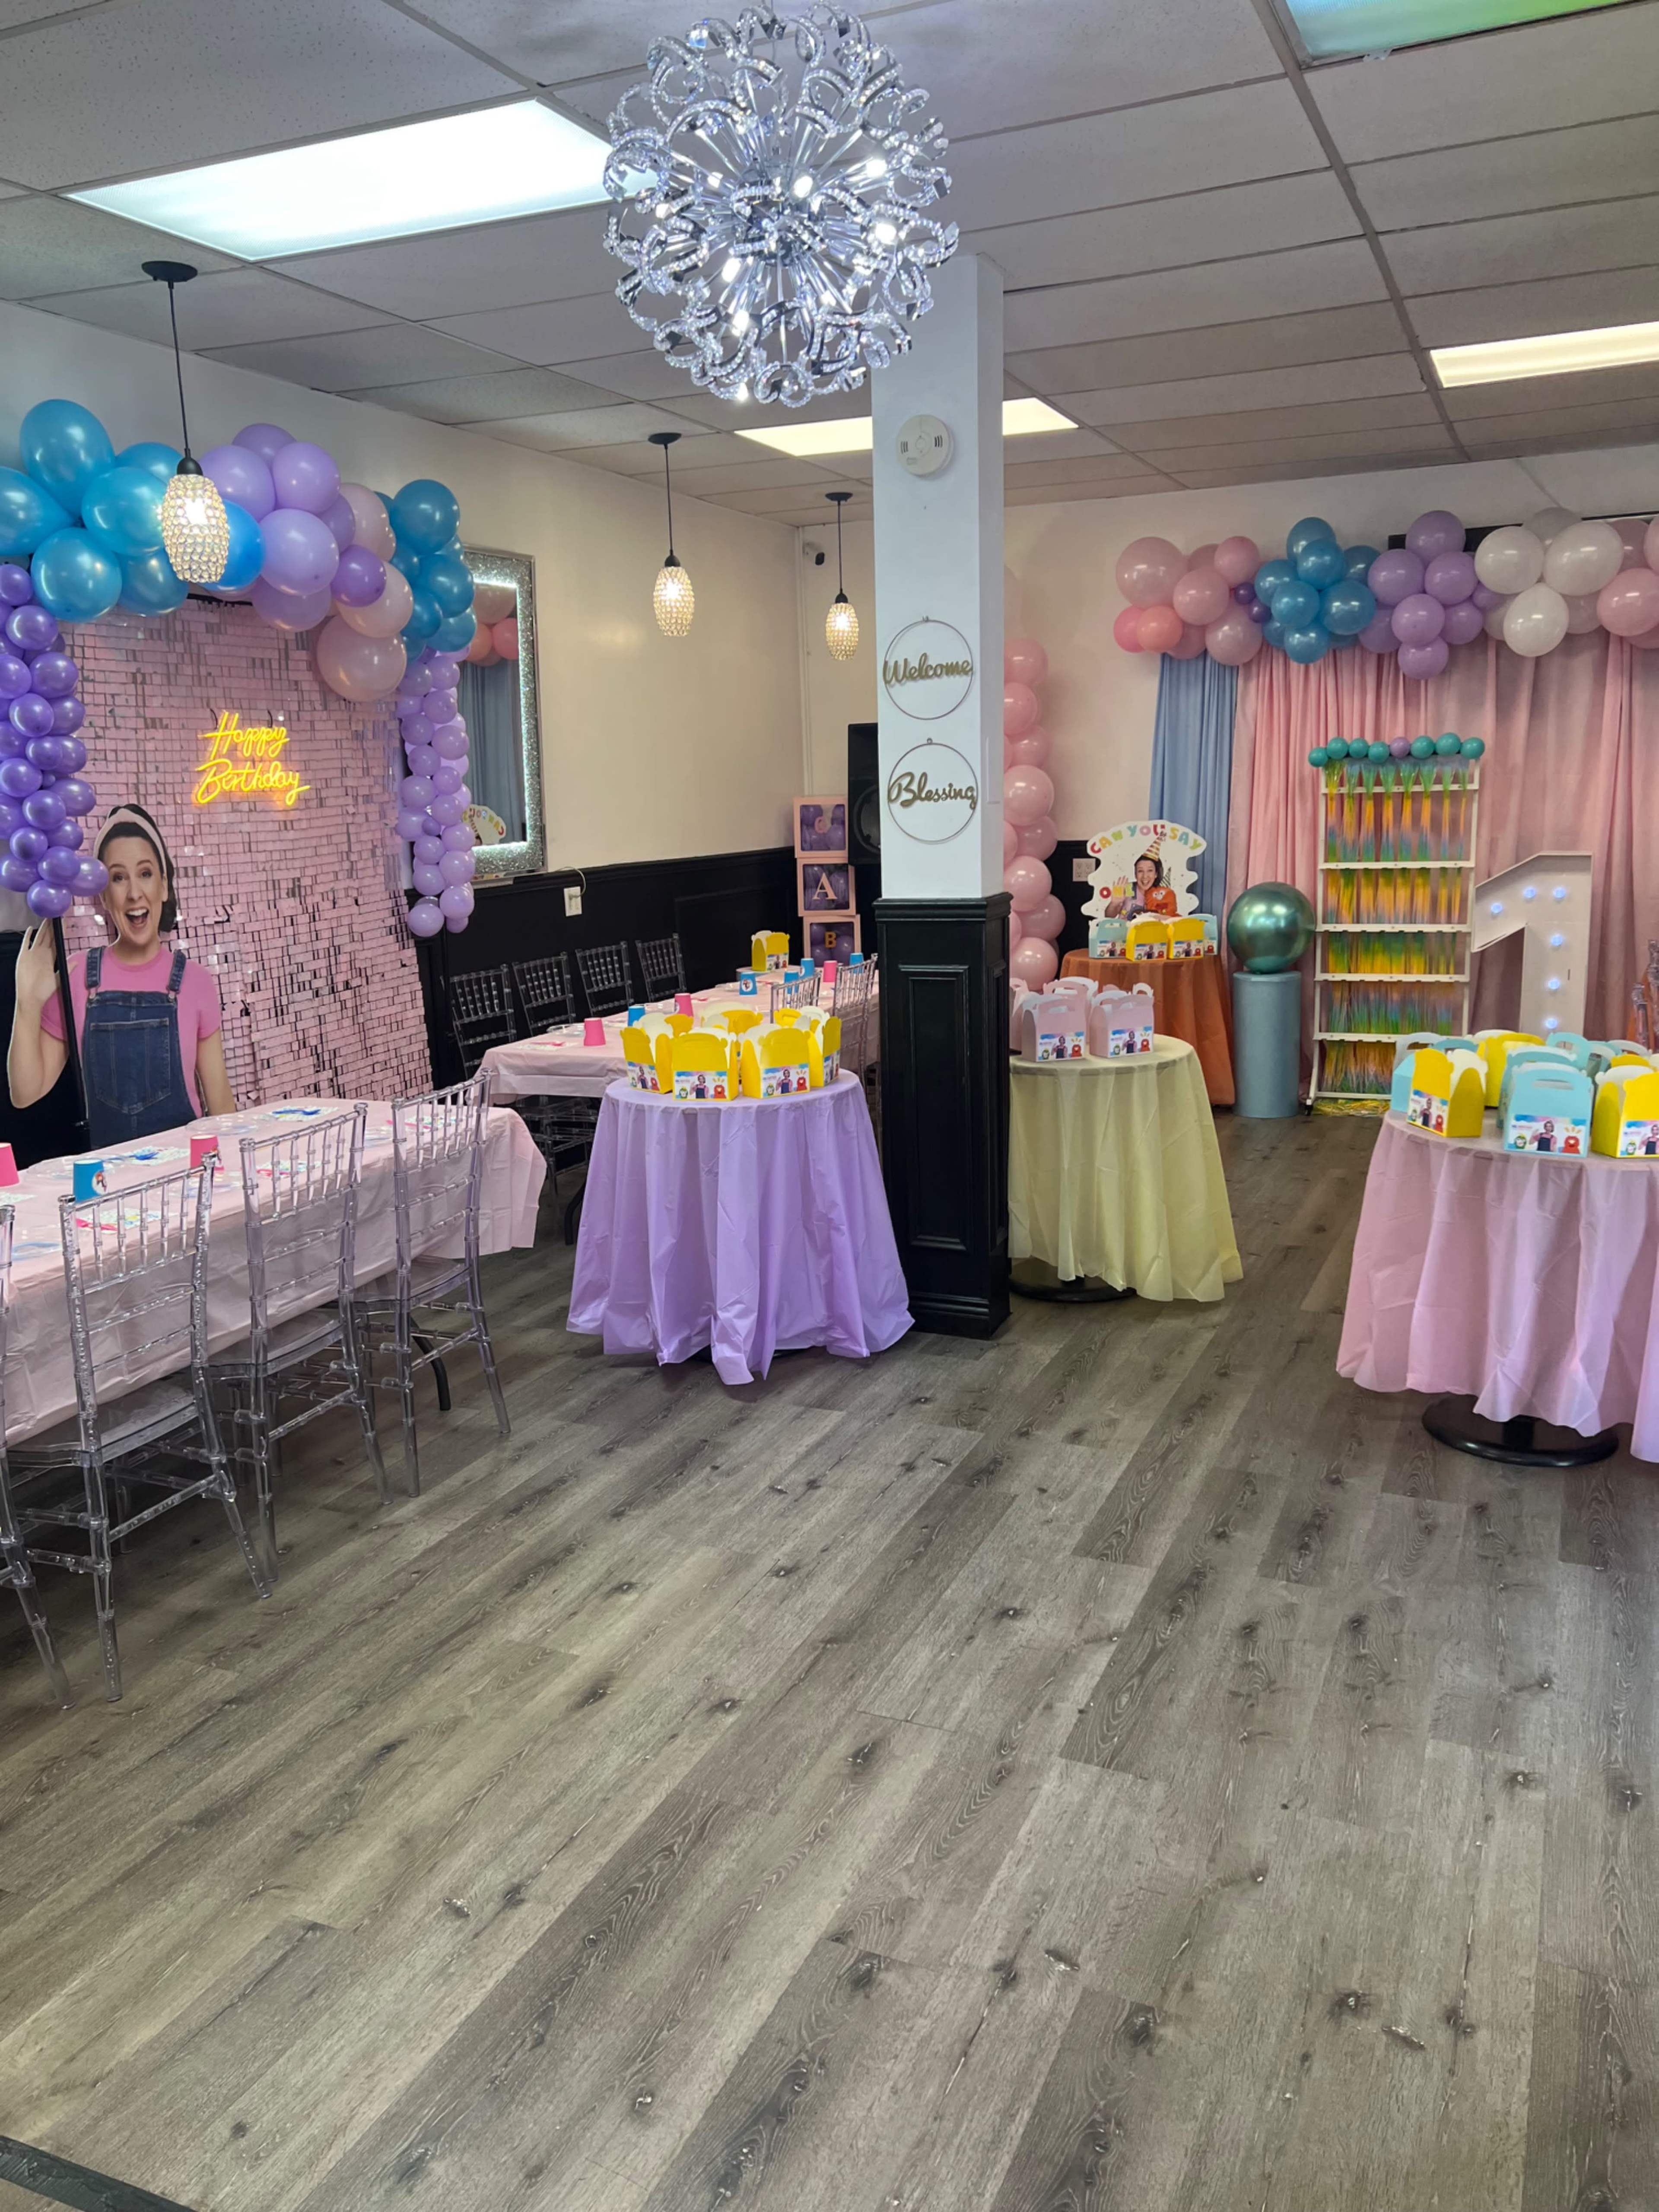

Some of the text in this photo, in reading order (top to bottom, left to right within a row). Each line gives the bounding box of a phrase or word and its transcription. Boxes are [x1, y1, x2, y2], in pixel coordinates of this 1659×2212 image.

[883, 652, 973, 684] Welcome
[198, 711, 290, 760] Happy
[195, 758, 311, 806] Birthday
[887, 772, 976, 810] Blessing
[1090, 824, 1202, 854] CAN YOU SAY
[812, 872, 838, 899] A
[824, 931, 837, 948] B
